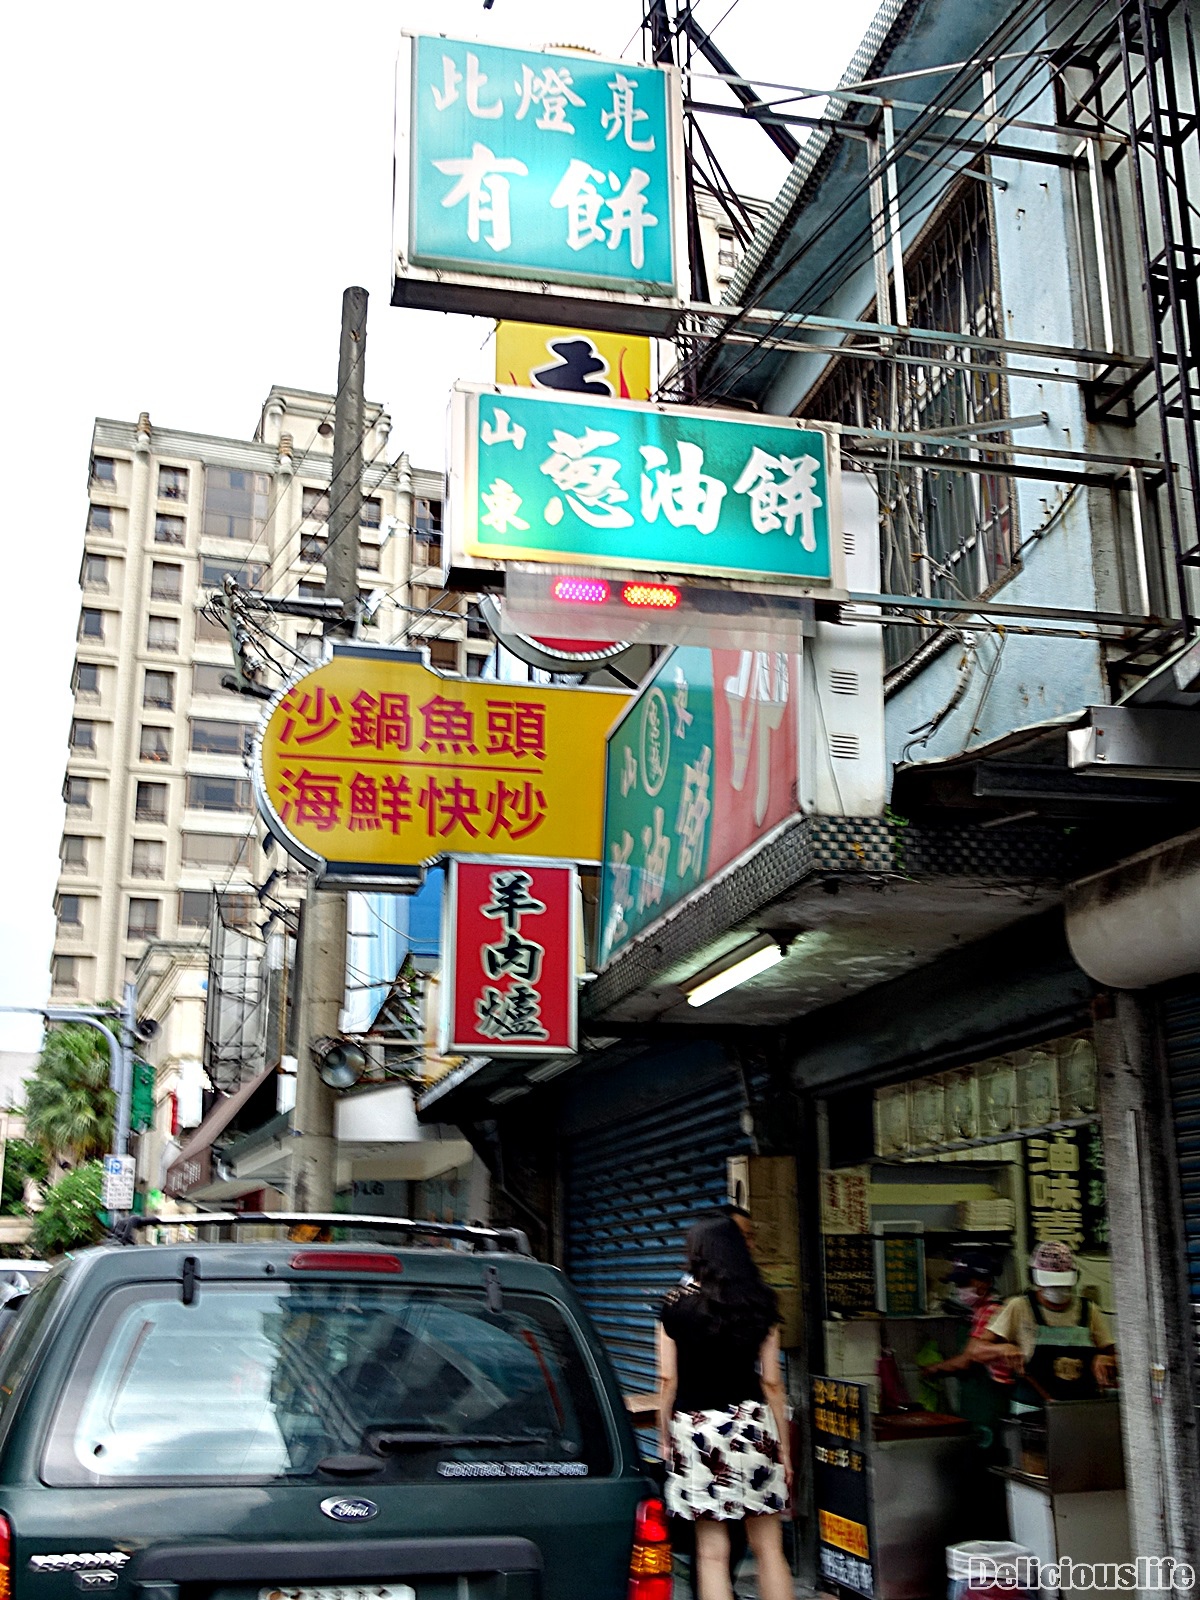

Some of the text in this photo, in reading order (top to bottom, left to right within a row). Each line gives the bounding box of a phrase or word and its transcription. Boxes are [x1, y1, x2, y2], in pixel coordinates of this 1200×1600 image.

[430, 50, 656, 152] 此燈亮
[430, 141, 659, 270] 有餅
[479, 406, 531, 534] 山東
[278, 686, 548, 761] 沙鍋魚頭
[275, 768, 549, 841] 海鮮快炒
[474, 869, 550, 1042] 羊肉爐
[438, 1462, 506, 1476] CONTROL
[338, 1503, 369, 1517] Ford
[30, 1552, 130, 1572] ESCAPE
